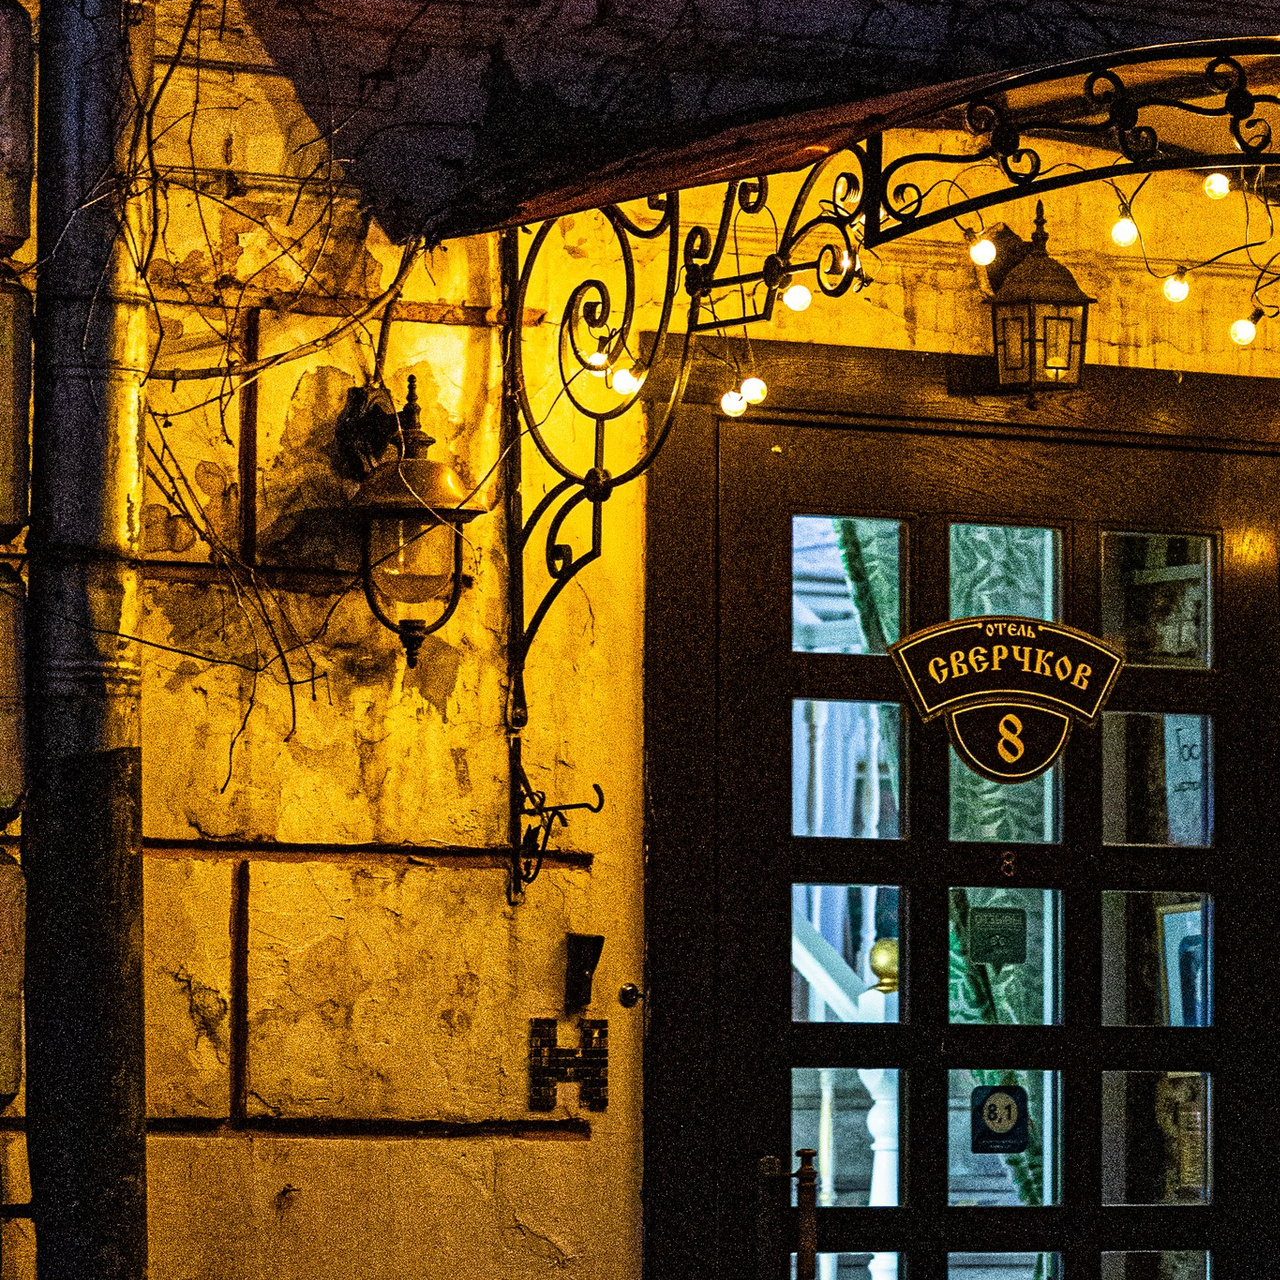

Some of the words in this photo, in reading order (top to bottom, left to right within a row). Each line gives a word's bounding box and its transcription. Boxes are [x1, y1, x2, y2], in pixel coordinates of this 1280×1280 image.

[928, 644, 1093, 690] СВЕРЧКОВ
[997, 713, 1025, 763] 8
[1000, 850, 1016, 878] 8
[987, 1103, 1012, 1123] 8,1
